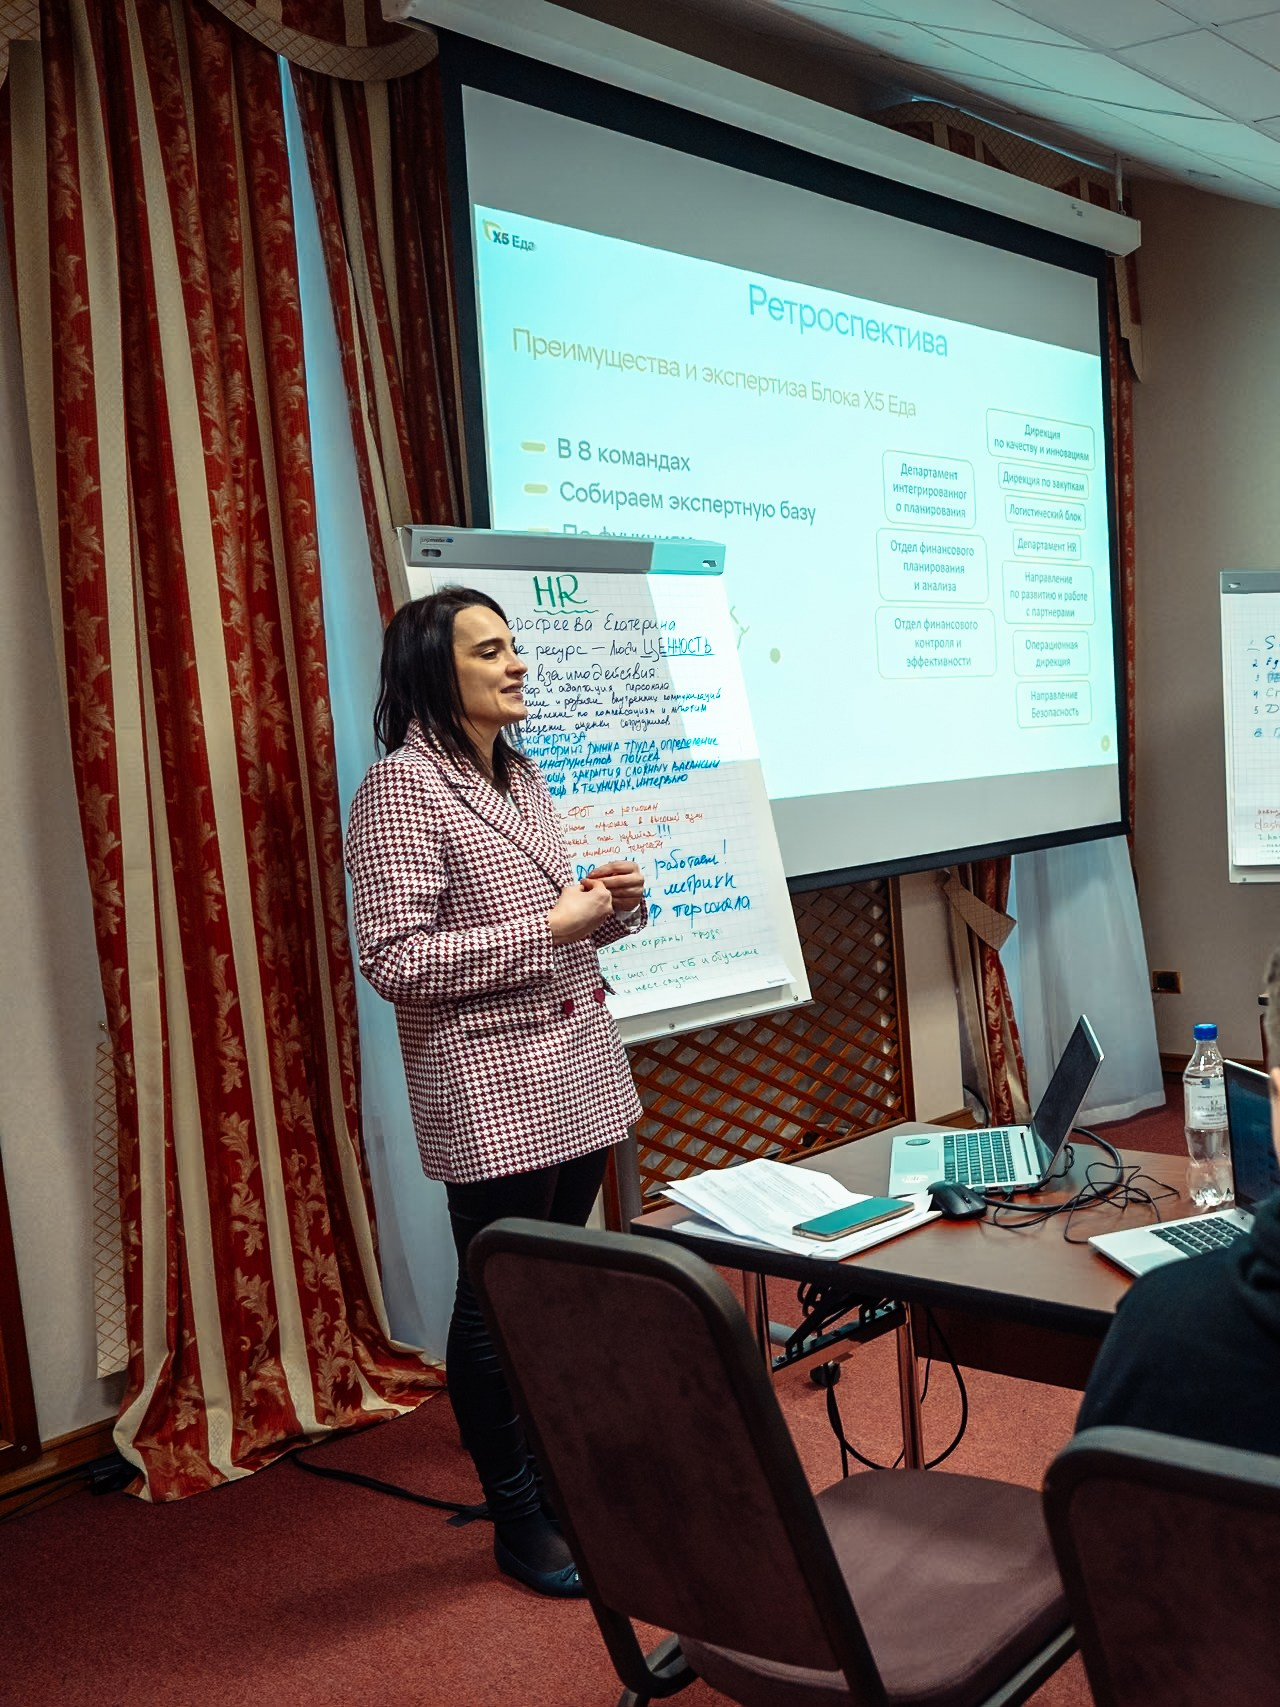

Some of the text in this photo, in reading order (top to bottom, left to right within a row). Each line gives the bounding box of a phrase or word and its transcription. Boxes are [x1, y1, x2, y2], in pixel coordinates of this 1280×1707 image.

[511, 235, 537, 252] Еда
[749, 283, 948, 356] Ретроспектива
[512, 327, 680, 378] Преимущества
[685, 364, 698, 381] и
[702, 365, 807, 396] экспертиза
[811, 381, 860, 408] Блока
[889, 395, 916, 418] Еда
[1024, 424, 1061, 441] Дирекция
[557, 438, 691, 472] В 8 командах
[994, 438, 1005, 448] по
[1006, 441, 1037, 456] качеству
[1046, 446, 1090, 462] инновациям
[900, 463, 958, 481] Департамент
[1003, 471, 1085, 492] Дирекция по закупкам
[893, 483, 967, 501] интегрированног
[560, 481, 816, 526] Собираем экспертную базу
[896, 503, 966, 519] о планирования
[1009, 504, 1082, 523] Логистический блок
[890, 540, 975, 557] Отдел финансового
[1017, 538, 1065, 553] Департамент
[903, 561, 965, 575] планирования
[1025, 571, 1073, 585] Направление
[533, 574, 588, 608] HR
[914, 582, 957, 593] и анализа
[1010, 590, 1088, 602] по развитию и работе
[1032, 608, 1075, 618] партнерами
[604, 613, 676, 635] Екатерина
[894, 618, 979, 632] Отдел финансового
[536, 645, 588, 663] ресурс
[643, 636, 712, 662] ЦЕННОСТЬ
[915, 638, 962, 650] контроля и
[1025, 639, 1078, 652] Операционная
[906, 655, 971, 669] эффективности
[1036, 657, 1071, 668] дирекция
[625, 682, 670, 692] персонала
[1031, 690, 1078, 702] Направление
[1031, 707, 1080, 719] Безопасность
